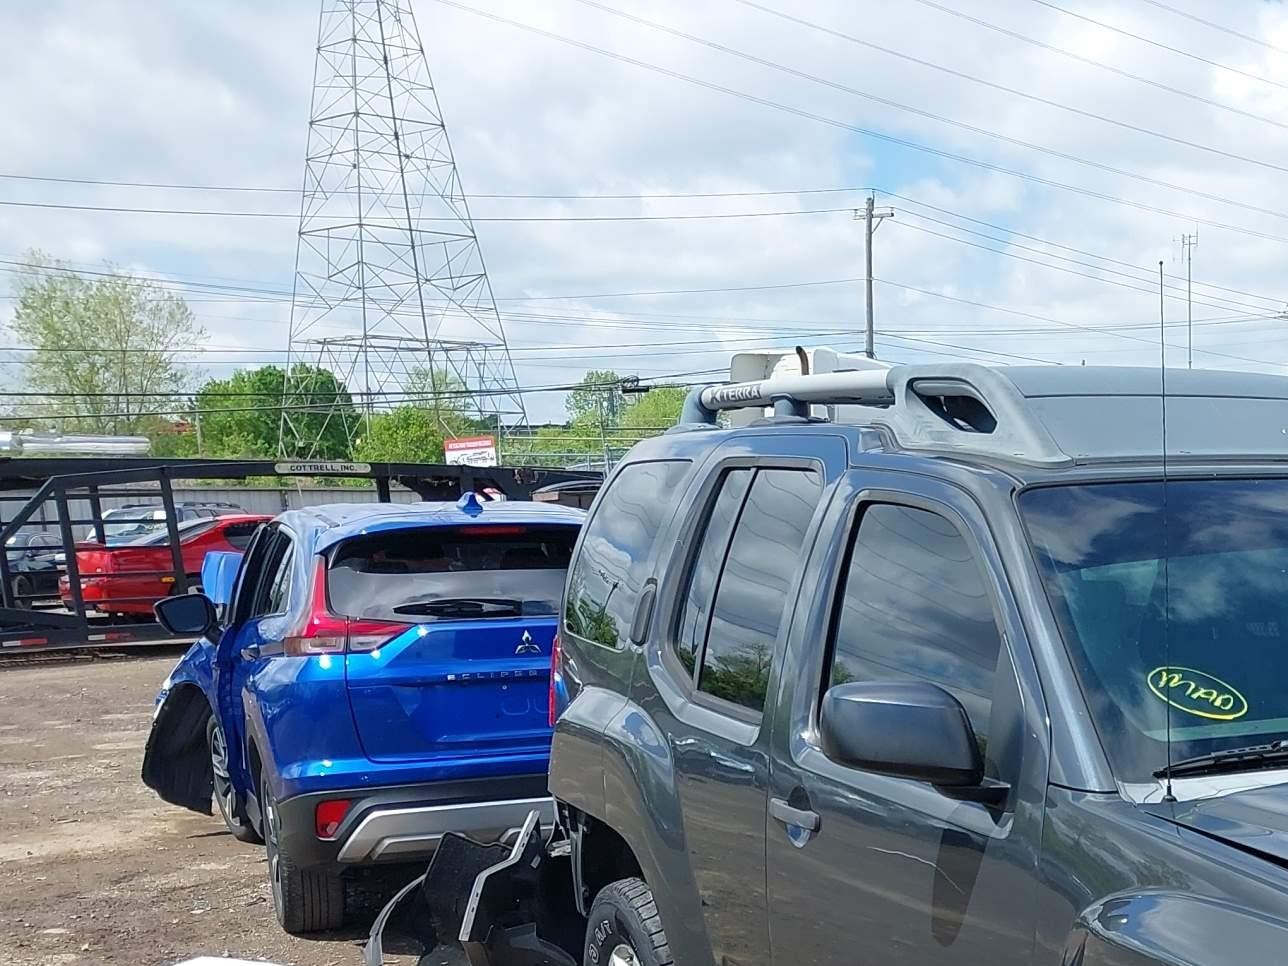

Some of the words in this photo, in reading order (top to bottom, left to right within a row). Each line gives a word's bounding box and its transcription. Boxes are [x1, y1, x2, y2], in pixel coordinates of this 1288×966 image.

[710, 385, 762, 404] XTERRA
[289, 464, 340, 472] COTTRELL,
[340, 464, 358, 472] INC.
